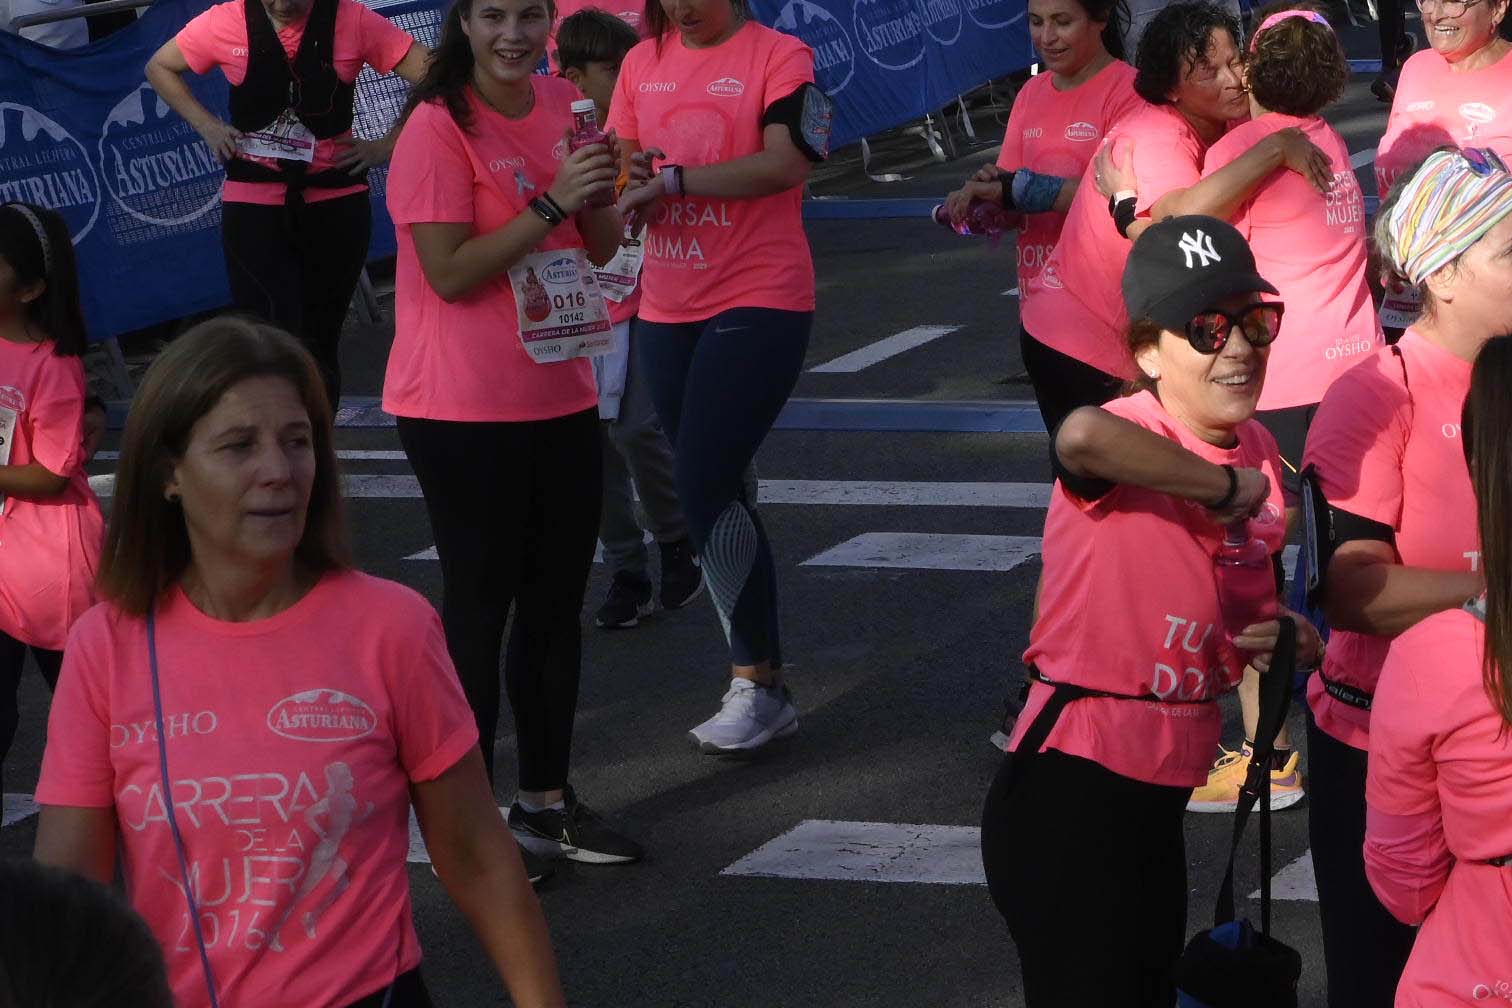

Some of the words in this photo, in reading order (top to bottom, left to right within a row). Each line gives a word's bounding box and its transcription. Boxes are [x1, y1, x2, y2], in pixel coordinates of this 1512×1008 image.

[639, 81, 676, 93] OYSHO
[1326, 192, 1343, 206] DE
[1346, 190, 1360, 205] LA
[655, 202, 732, 227] ORSAL
[553, 291, 586, 310] 016
[558, 311, 585, 325] 10142
[531, 329, 561, 339] CARRERA
[1325, 340, 1371, 360] OYSHO
[1163, 613, 1213, 653] TU
[275, 708, 369, 730] ASTURIANA
[118, 770, 319, 832] CARRERA
[236, 828, 268, 852] DE
[272, 828, 306, 852] LA
